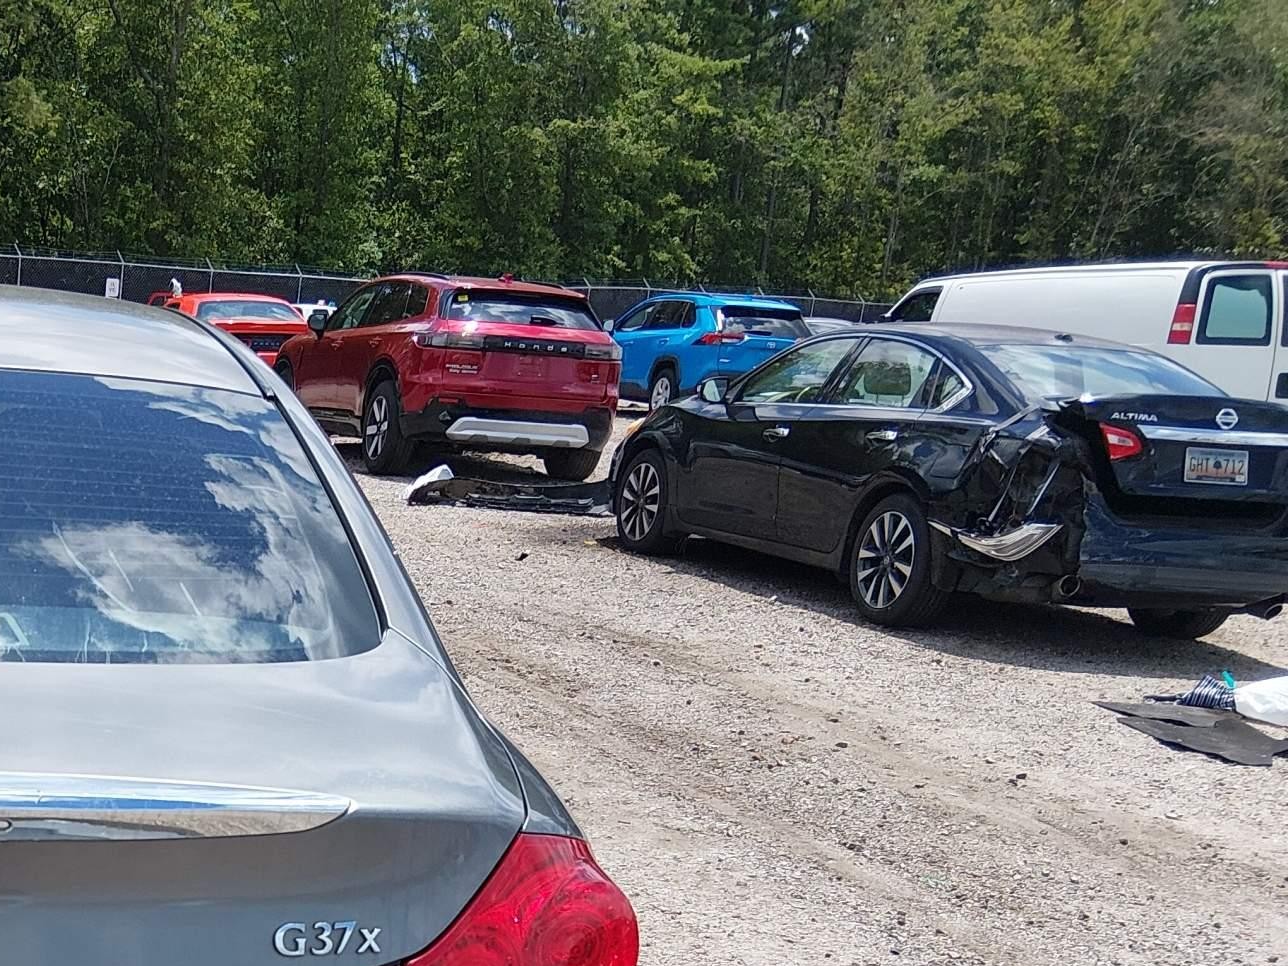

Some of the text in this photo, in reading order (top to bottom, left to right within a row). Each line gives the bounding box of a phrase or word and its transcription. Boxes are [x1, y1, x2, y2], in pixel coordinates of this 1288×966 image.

[504, 341, 568, 352] Honda
[1111, 411, 1159, 422] ALTIMA
[1189, 456, 1245, 476] GHT 712
[274, 920, 382, 957] G37x
